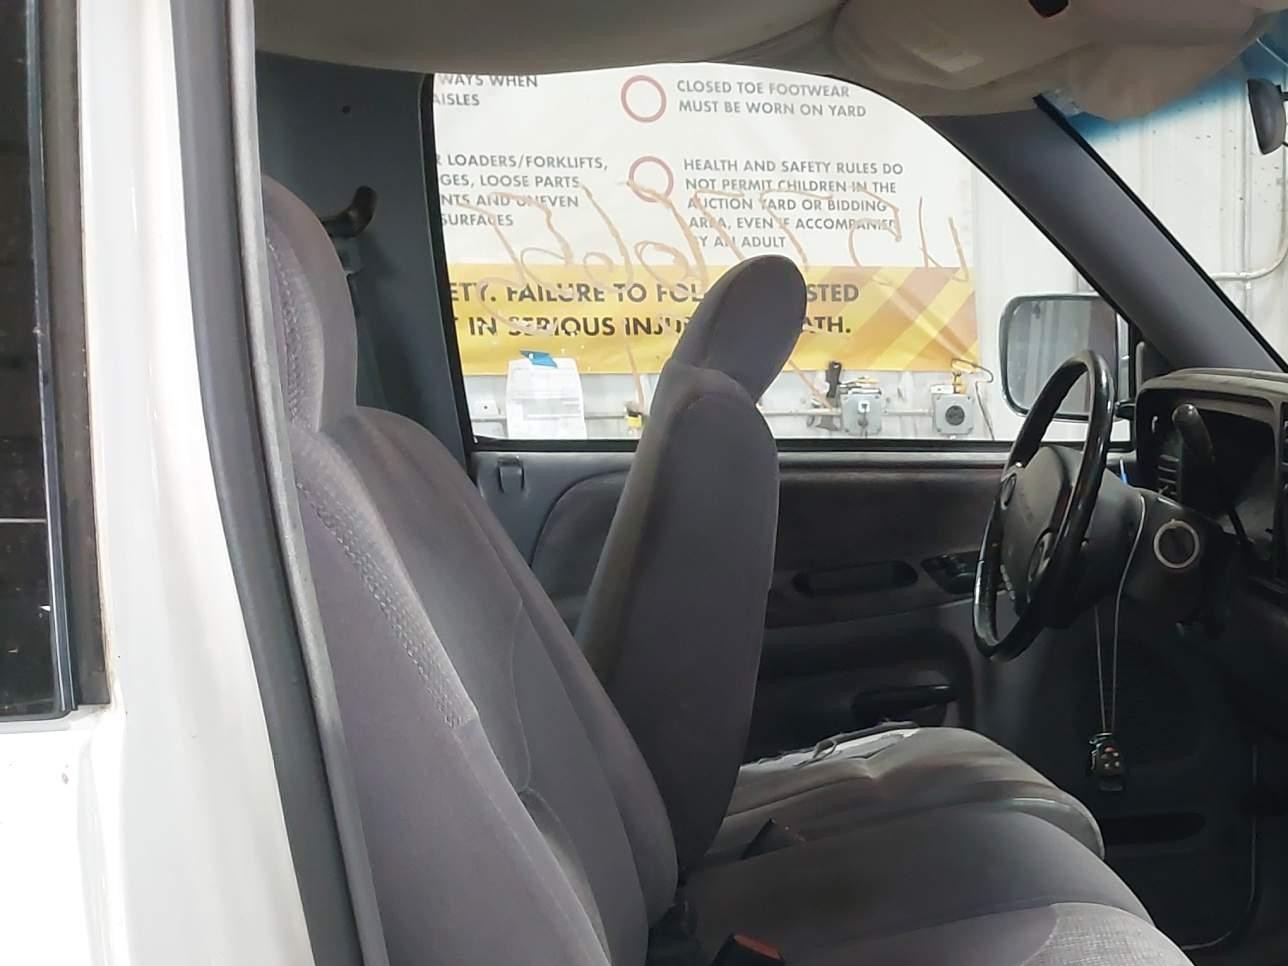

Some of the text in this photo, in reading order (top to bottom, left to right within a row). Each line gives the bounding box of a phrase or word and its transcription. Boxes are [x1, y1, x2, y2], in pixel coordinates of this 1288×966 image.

[489, 74, 538, 87] WHEN
[677, 80, 850, 97] CLOSED TOE FOOTWEAR
[679, 100, 866, 117] MUST BE WORN ON YARD
[448, 154, 608, 171] LOADERS/FORKLIFTS,
[684, 159, 903, 175] HEALTH AND SAFETY RULES DO
[440, 174, 579, 188] GES, LOOSE PARTS
[686, 178, 717, 191] NOT
[722, 179, 773, 191] PERMIT
[778, 180, 847, 192] CHILDREN
[872, 182, 896, 193] THE
[476, 194, 510, 206] AND
[802, 199, 822, 211] OR
[827, 200, 887, 212] BIDDING
[689, 217, 732, 230] ARA,
[737, 218, 773, 229] EVEN
[741, 236, 786, 248] ADULT
[614, 283, 647, 302] TO
[469, 317, 497, 335] IN
